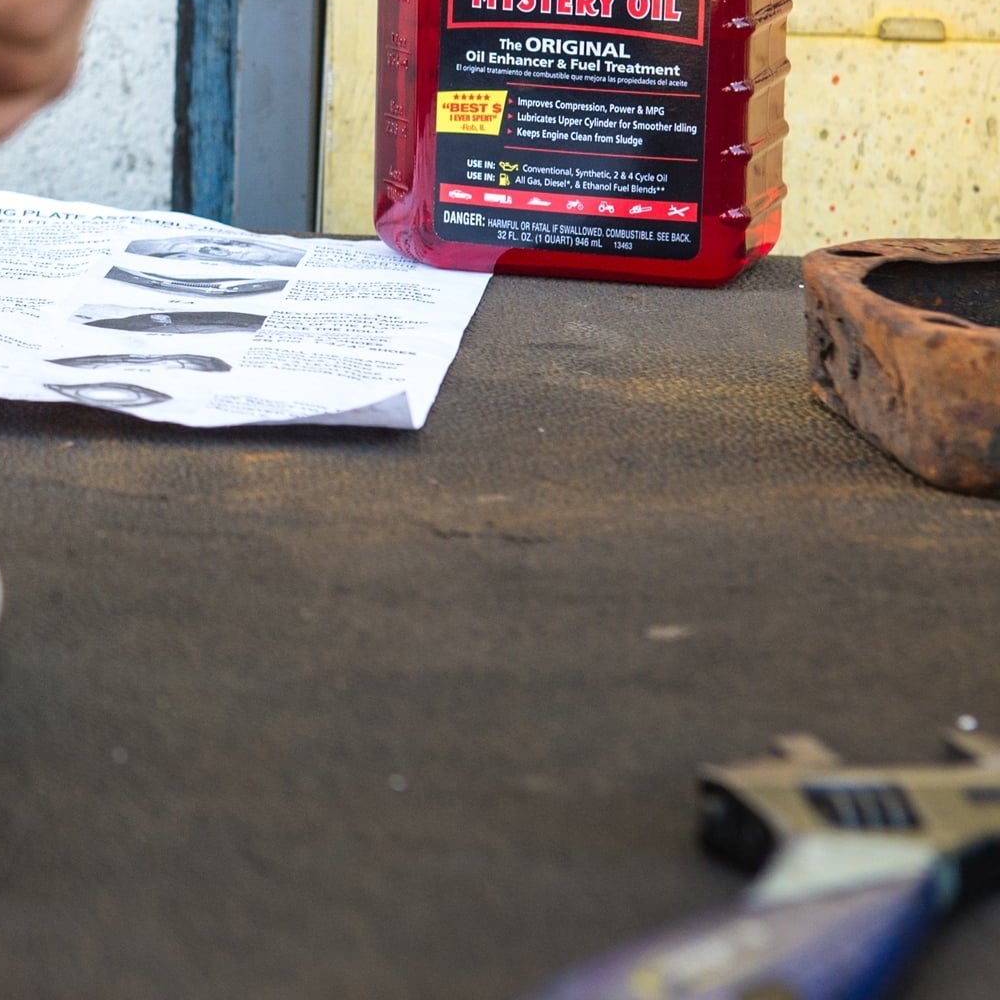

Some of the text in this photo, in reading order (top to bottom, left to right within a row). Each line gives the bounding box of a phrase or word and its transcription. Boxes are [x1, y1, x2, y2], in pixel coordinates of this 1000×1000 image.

[499, 37, 631, 59] The ORIGINAL
[465, 50, 681, 77] Oil Enhancer & Fuel Treatment
[463, 64, 486, 74] original
[486, 67, 523, 76] tratamiento
[523, 69, 532, 77] de
[533, 70, 569, 80] combustible
[571, 74, 584, 82] que
[584, 74, 606, 83] mejora
[617, 77, 656, 86] propiedades
[668, 79, 688, 87] aceite
[492, 102, 502, 113] $
[517, 97, 665, 116] Improves Compression, Power & MPG
[454, 114, 470, 122] EVER
[517, 112, 697, 135] Lubricates Upper Cylinder for Smoother Idling
[516, 127, 643, 147] Keeps Engine Clean from Sludge
[466, 171, 482, 180] USE
[484, 173, 496, 182] IN:
[515, 175, 526, 185] All
[527, 177, 543, 187] Gas,
[575, 180, 580, 189] &
[582, 181, 612, 191] Ethanol
[613, 183, 629, 192] Fuel
[467, 159, 668, 183] USE IN: Conventional, Synthetic, 2 & 4 Cycle Oil
[443, 210, 692, 243] DANGER: HARMFUL OR FATAL IF SWALLOWED. COMBUSTIBLE. SEE BACK.
[497, 230, 603, 248] 32 FL. OZ. (1 QUART) 946 mL
[614, 241, 633, 250] 13463
